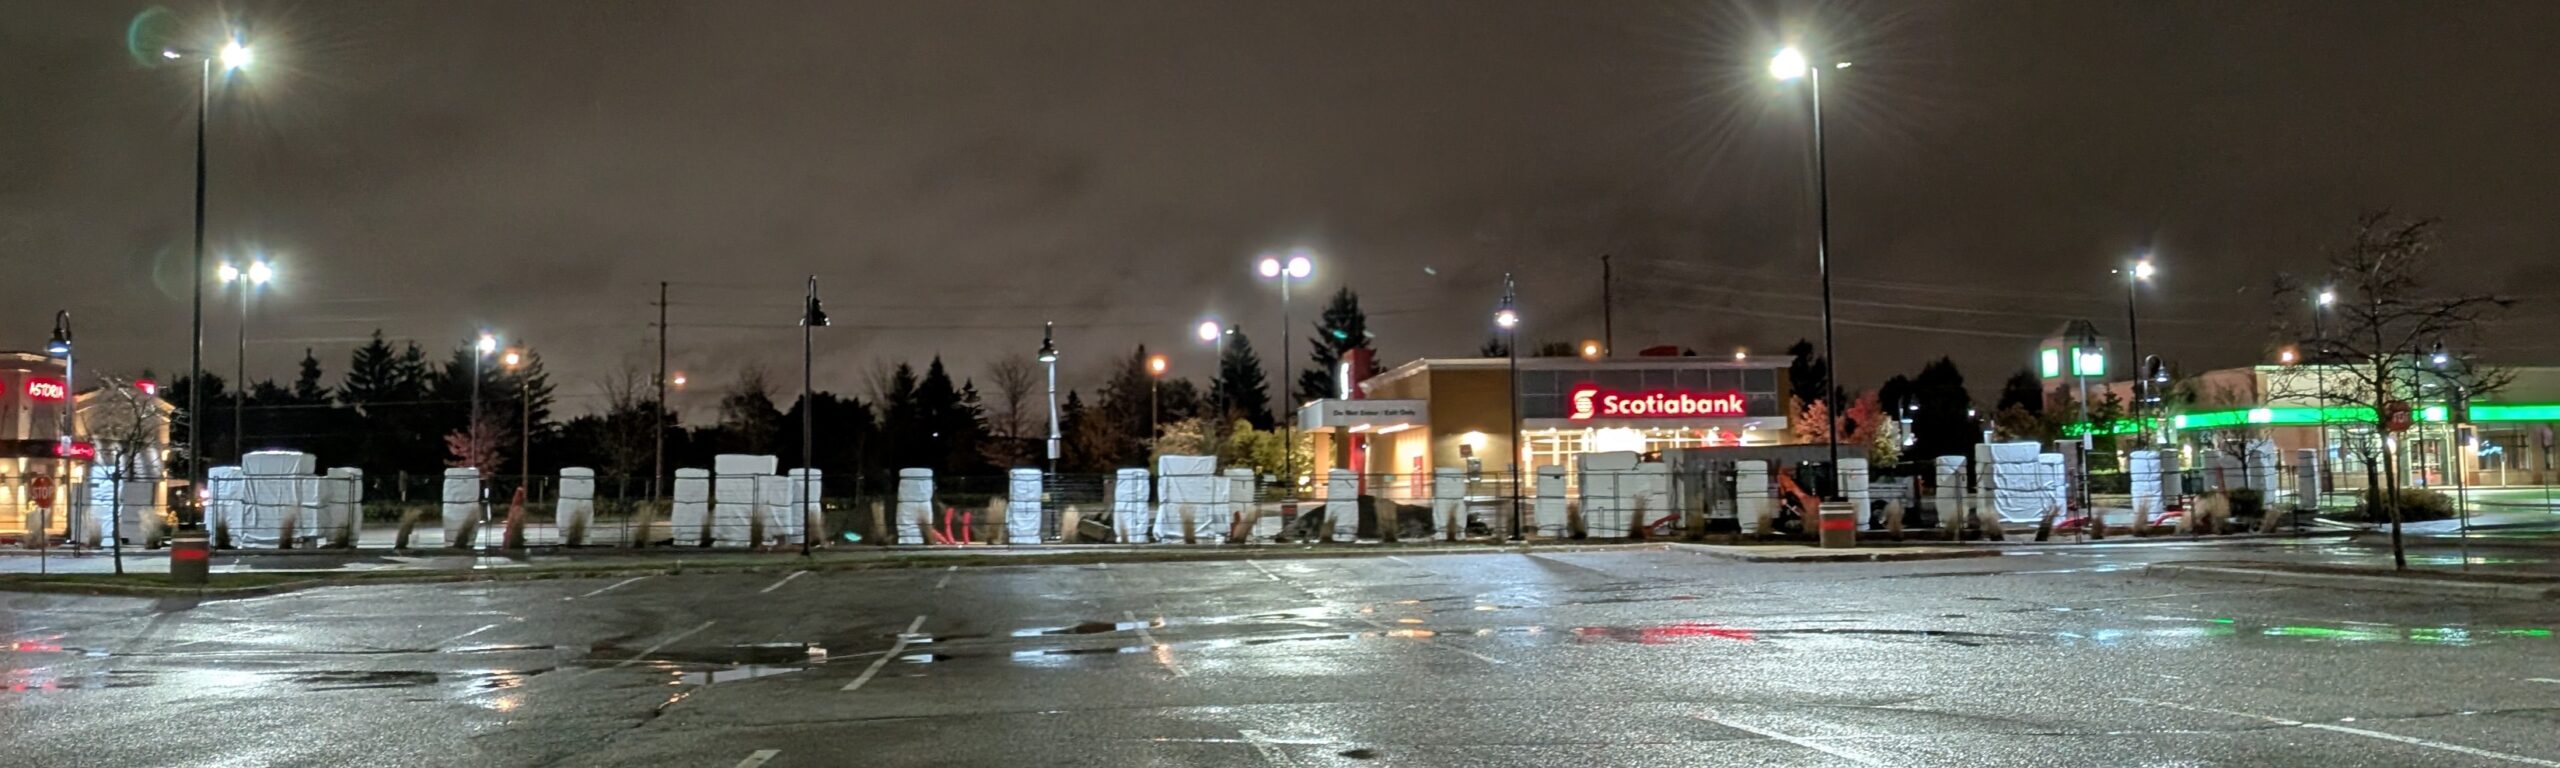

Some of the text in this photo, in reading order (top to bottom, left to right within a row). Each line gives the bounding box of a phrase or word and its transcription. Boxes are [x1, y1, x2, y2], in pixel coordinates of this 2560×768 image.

[29, 381, 65, 399] ASTORIA
[1603, 393, 1744, 415] Scotiabank
[32, 486, 53, 500] STOP
